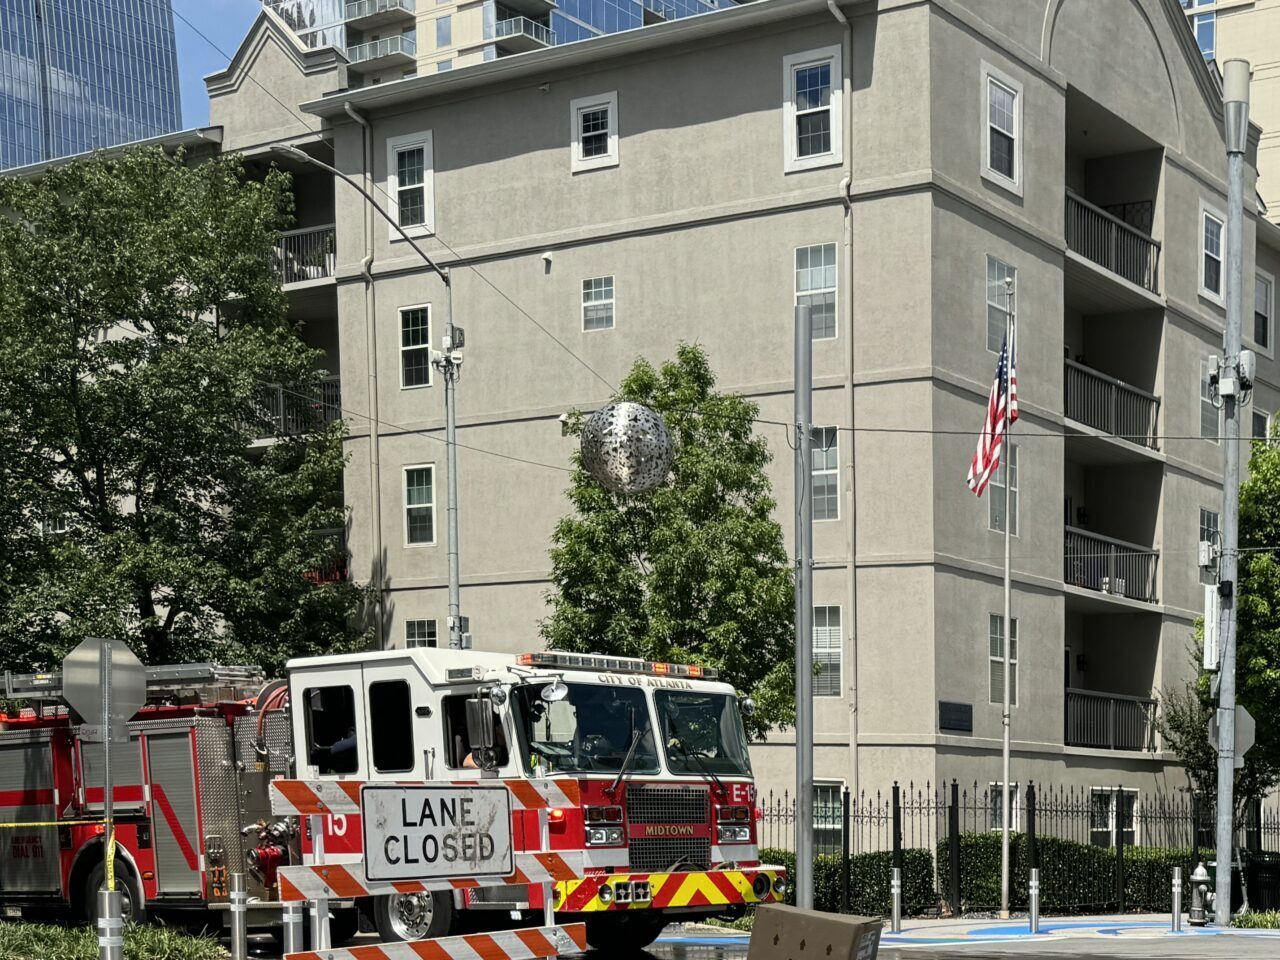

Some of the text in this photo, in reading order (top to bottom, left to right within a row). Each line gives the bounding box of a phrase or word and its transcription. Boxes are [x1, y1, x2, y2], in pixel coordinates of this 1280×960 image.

[597, 674, 693, 690] CITY OF ATLANTA
[401, 797, 475, 828] LANE
[645, 825, 694, 836] MIDTOWN
[384, 832, 495, 865] CLOSED
